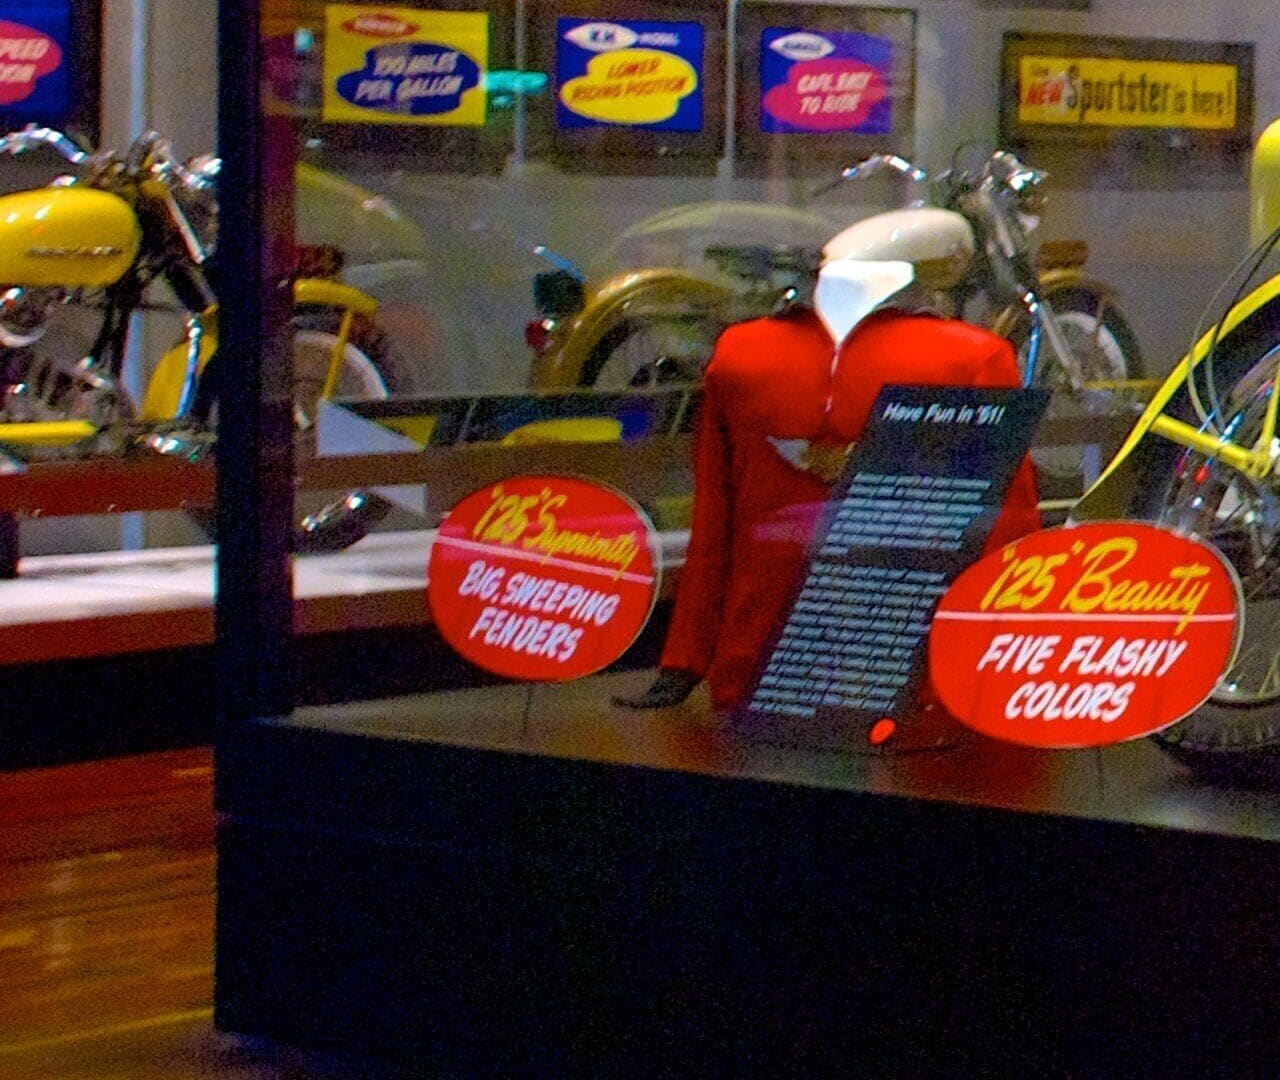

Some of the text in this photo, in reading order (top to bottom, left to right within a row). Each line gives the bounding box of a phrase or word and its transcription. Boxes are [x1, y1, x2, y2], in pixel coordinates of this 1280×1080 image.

[353, 75, 465, 101] PER GALLON
[1066, 66, 1170, 122] Sportster
[881, 401, 926, 423] Have
[924, 403, 956, 423] Fun
[500, 571, 621, 627] SWEEPING
[1059, 536, 1212, 636] Beauty
[468, 606, 584, 663] FENDERS
[976, 633, 1189, 678] FIVE FLASHY
[1005, 680, 1137, 723] COLORS
